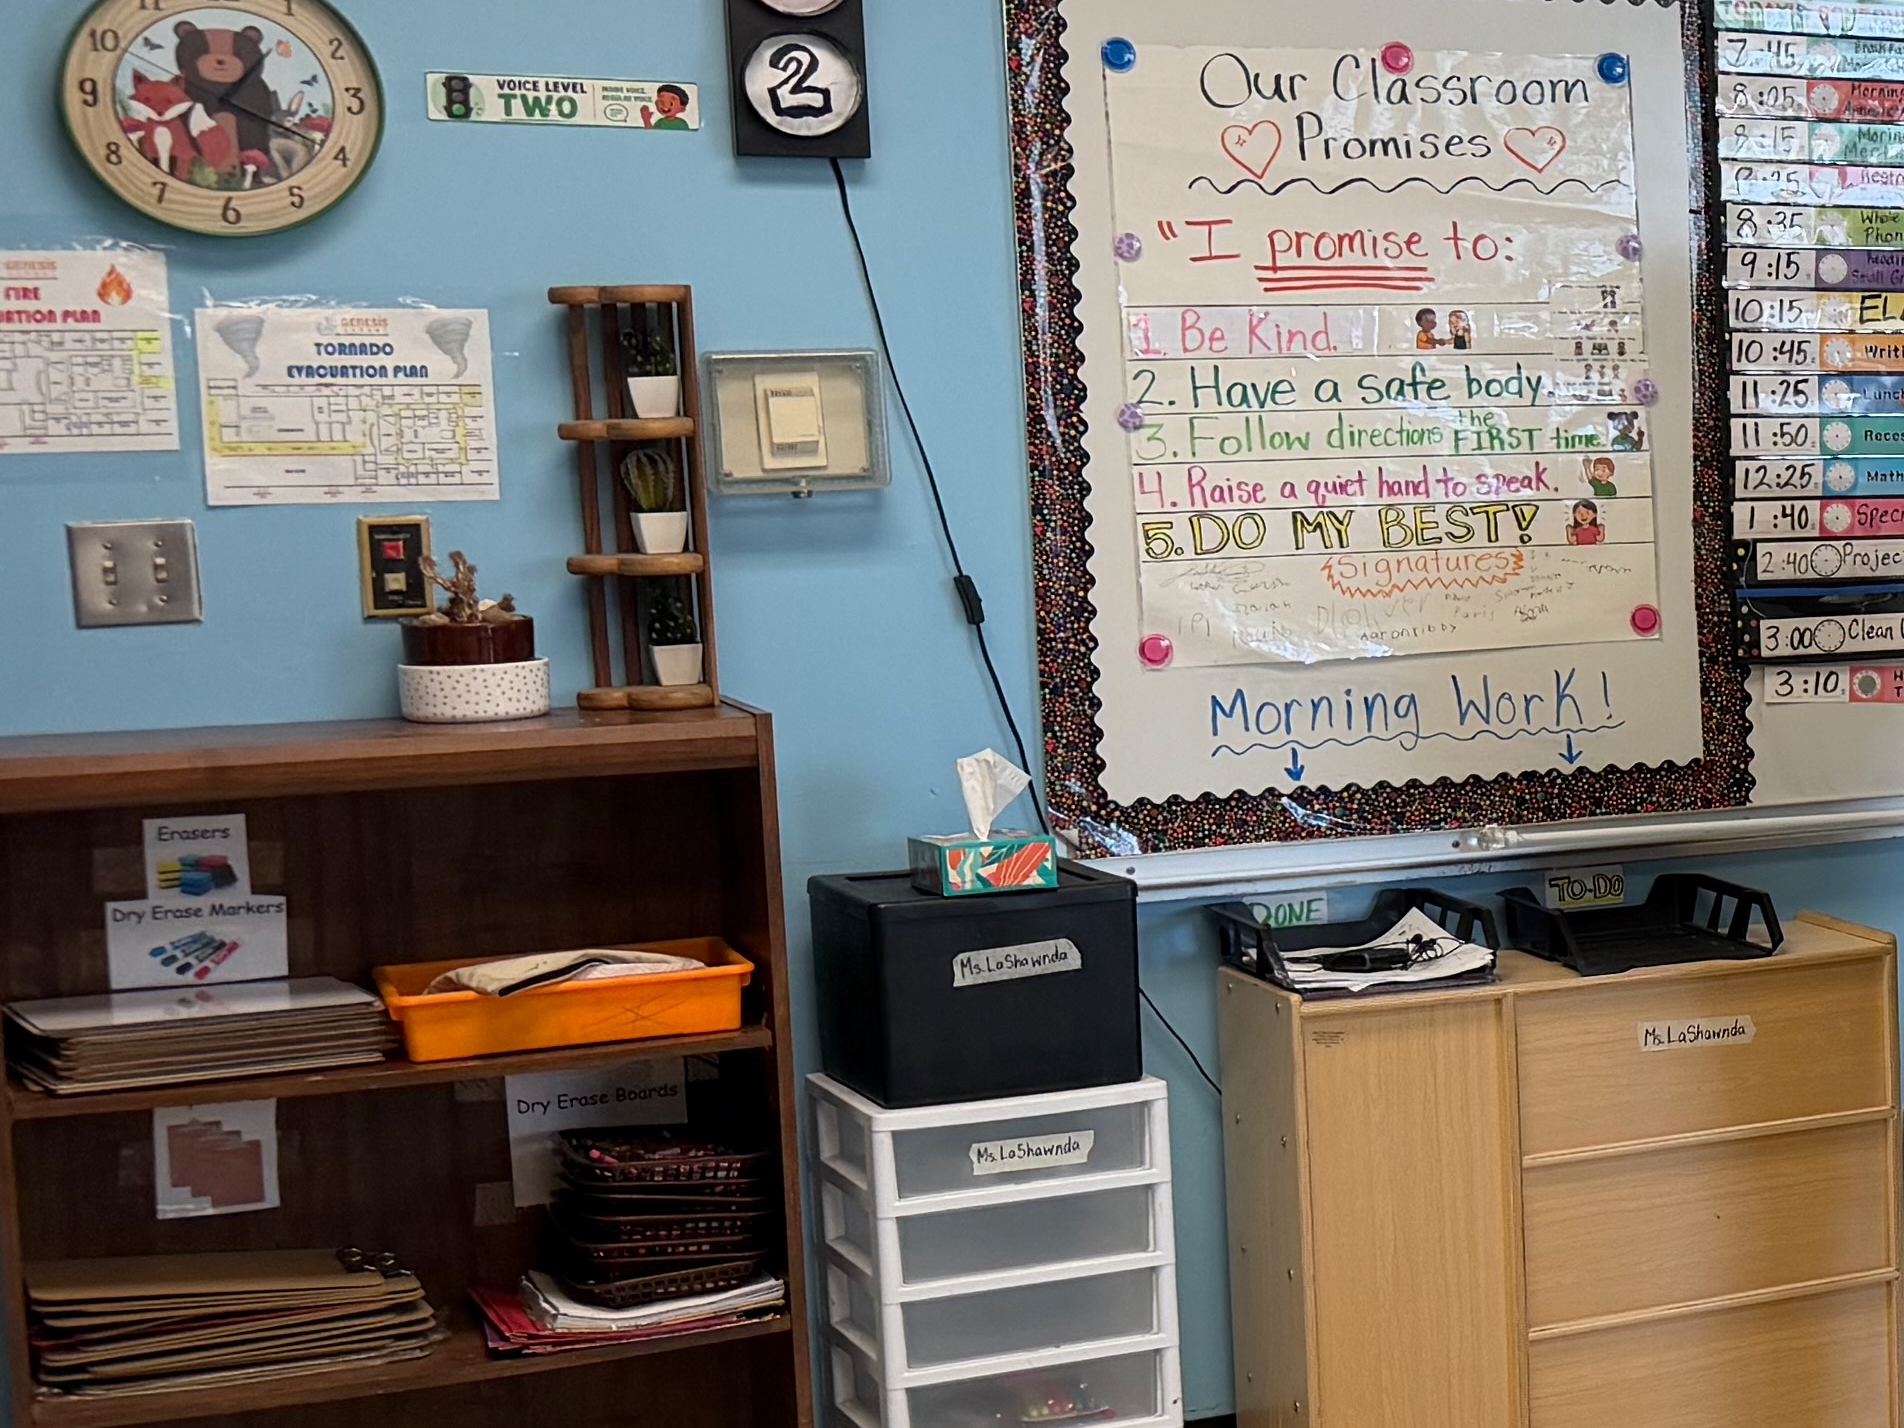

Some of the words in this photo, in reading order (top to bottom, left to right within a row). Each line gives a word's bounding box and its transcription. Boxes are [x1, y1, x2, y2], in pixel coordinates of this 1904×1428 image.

[89, 30, 120, 52] 10
[330, 38, 345, 61] 2
[79, 79, 98, 107] 9
[497, 79, 539, 92] VOICE
[545, 81, 587, 94] LEVEL
[768, 45, 833, 118] 2
[1201, 53, 1307, 109] Our
[1332, 53, 1589, 106] Classroom
[345, 88, 364, 114] 3
[498, 94, 578, 119] TWO
[1297, 113, 1492, 162] Promises
[222, 197, 241, 225] 6
[1269, 230, 1428, 272] promise
[1447, 221, 1514, 262] to:
[1742, 251, 1800, 280] 9:15
[5, 288, 40, 300] FIRE
[1734, 297, 1803, 323] 10:15
[1181, 309, 1226, 354] Be
[1248, 311, 1338, 354] Kind.
[315, 343, 394, 356] TORNADO
[1737, 339, 1808, 363] 10:45
[287, 365, 388, 379] EVACUATION
[393, 365, 428, 378] PLAN
[1191, 367, 1295, 408] Have
[1314, 379, 1340, 403] a
[1361, 366, 1451, 405] safe
[1466, 365, 1555, 400] body.
[1741, 378, 1809, 405] 11:25
[1188, 415, 1309, 456] Follow
[1328, 415, 1443, 451] directions
[1452, 429, 1542, 453] FIRST
[1743, 423, 1808, 448] 11:50
[1138, 479, 1177, 509] 4.
[1188, 468, 1266, 504] Raise
[1280, 483, 1299, 500] a
[1307, 472, 1366, 507] quiet
[1379, 469, 1428, 499] hand
[1437, 474, 1466, 497] to
[1476, 464, 1558, 502] speak.
[1744, 463, 1814, 490] 12:25
[1867, 470, 1904, 482] Math
[1143, 521, 1184, 559] 5.
[1192, 513, 1266, 549] DO
[1295, 509, 1355, 549] MY
[1378, 503, 1538, 547] BEST!
[1748, 506, 1808, 530] 1:40
[1338, 550, 1511, 587] Signatures
[1761, 548, 1808, 575] 2:40
[1766, 624, 1813, 652] 3:00
[1848, 618, 1896, 641] Clean
[1775, 670, 1838, 697] 3:10
[1212, 688, 1418, 750] Morning
[158, 824, 230, 842] Erasers
[1549, 873, 1624, 901] TO-DO
[112, 908, 145, 926] Dry
[152, 903, 203, 921] Erase
[209, 898, 284, 918] Markers
[1250, 898, 1324, 927] DONE
[516, 1096, 550, 1117] Dry
[557, 1090, 609, 1110] Erase
[615, 1081, 678, 1103] Boards
